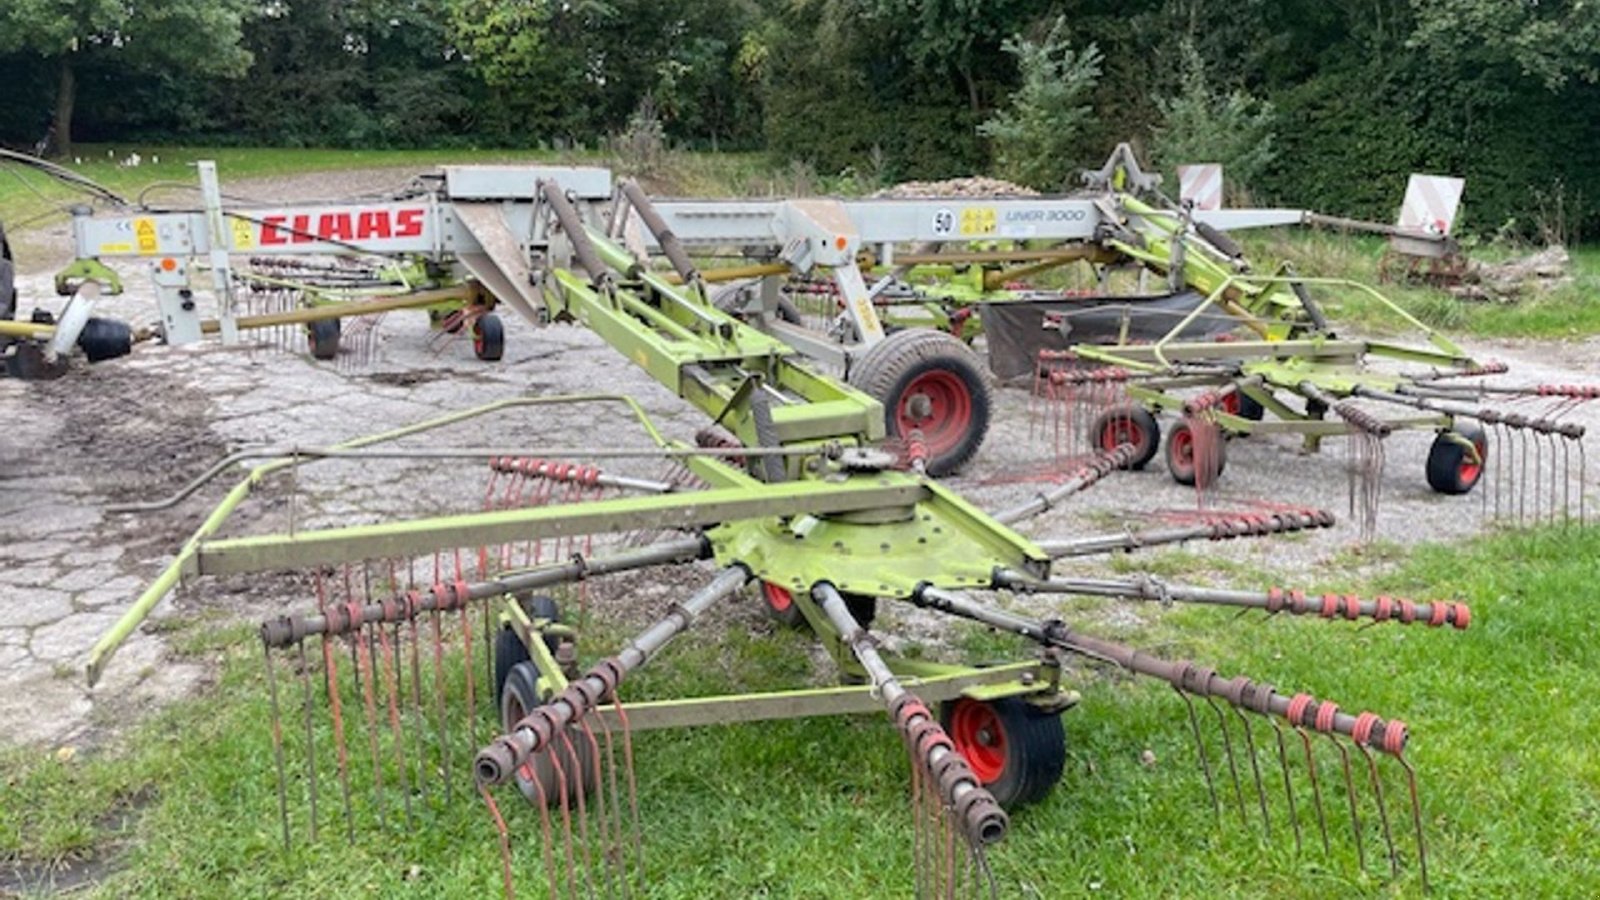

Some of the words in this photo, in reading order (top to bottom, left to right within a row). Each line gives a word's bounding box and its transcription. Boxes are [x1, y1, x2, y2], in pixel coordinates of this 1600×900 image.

[936, 213, 952, 232] 50
[1046, 210, 1086, 221] 3000
[260, 209, 424, 246] CLAAS
